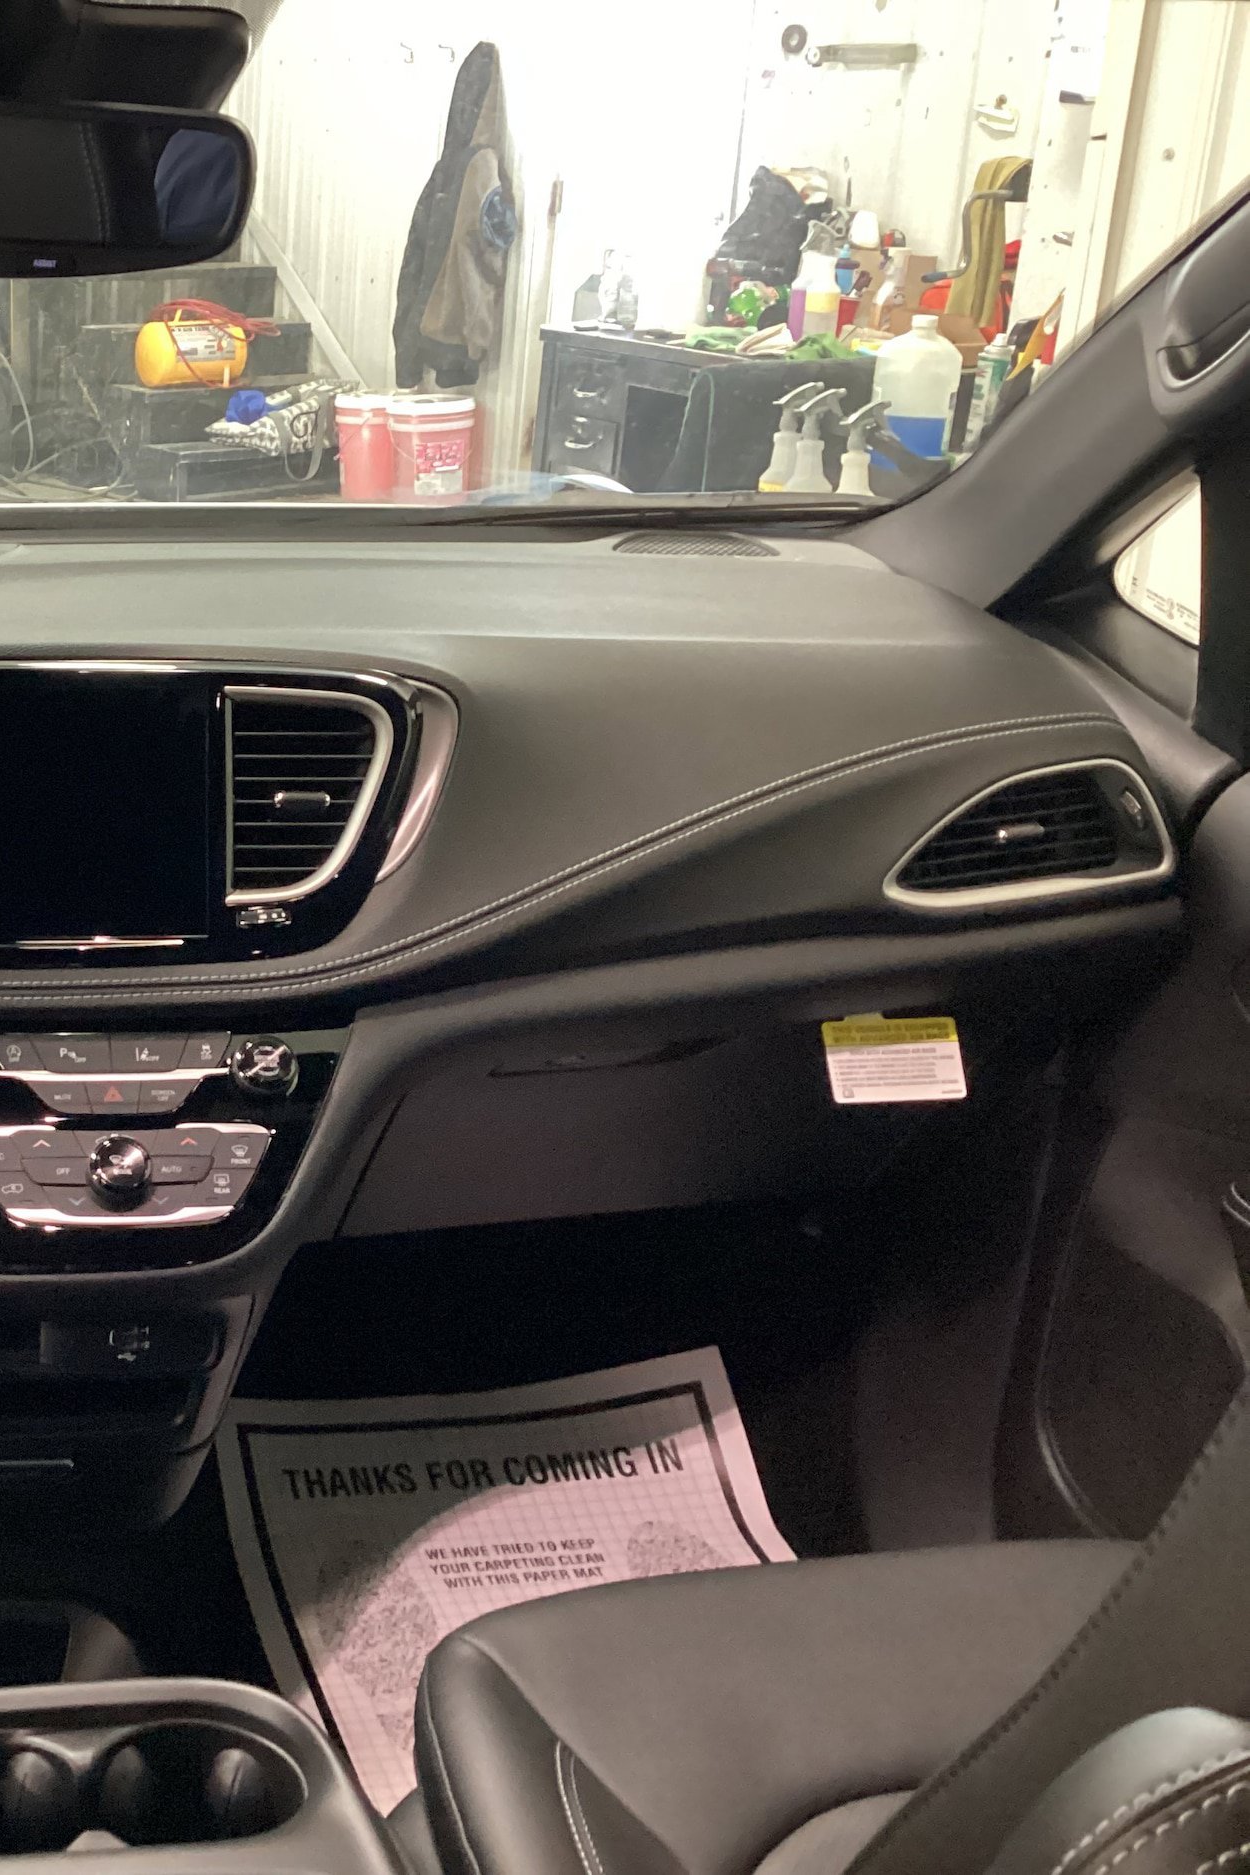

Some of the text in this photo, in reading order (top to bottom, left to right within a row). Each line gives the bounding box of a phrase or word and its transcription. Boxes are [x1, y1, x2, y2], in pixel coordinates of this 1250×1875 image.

[56, 1167, 71, 1175] OFF
[161, 1165, 183, 1173] AUTO
[281, 1438, 684, 1500] THANKS FOR COMING IN
[425, 1538, 595, 1560] WE HAVE TRIED TO KEEP
[430, 1553, 606, 1575] YOUR CARPETING CLEAN
[443, 1566, 604, 1589] WITH THIS PAPER MAT
